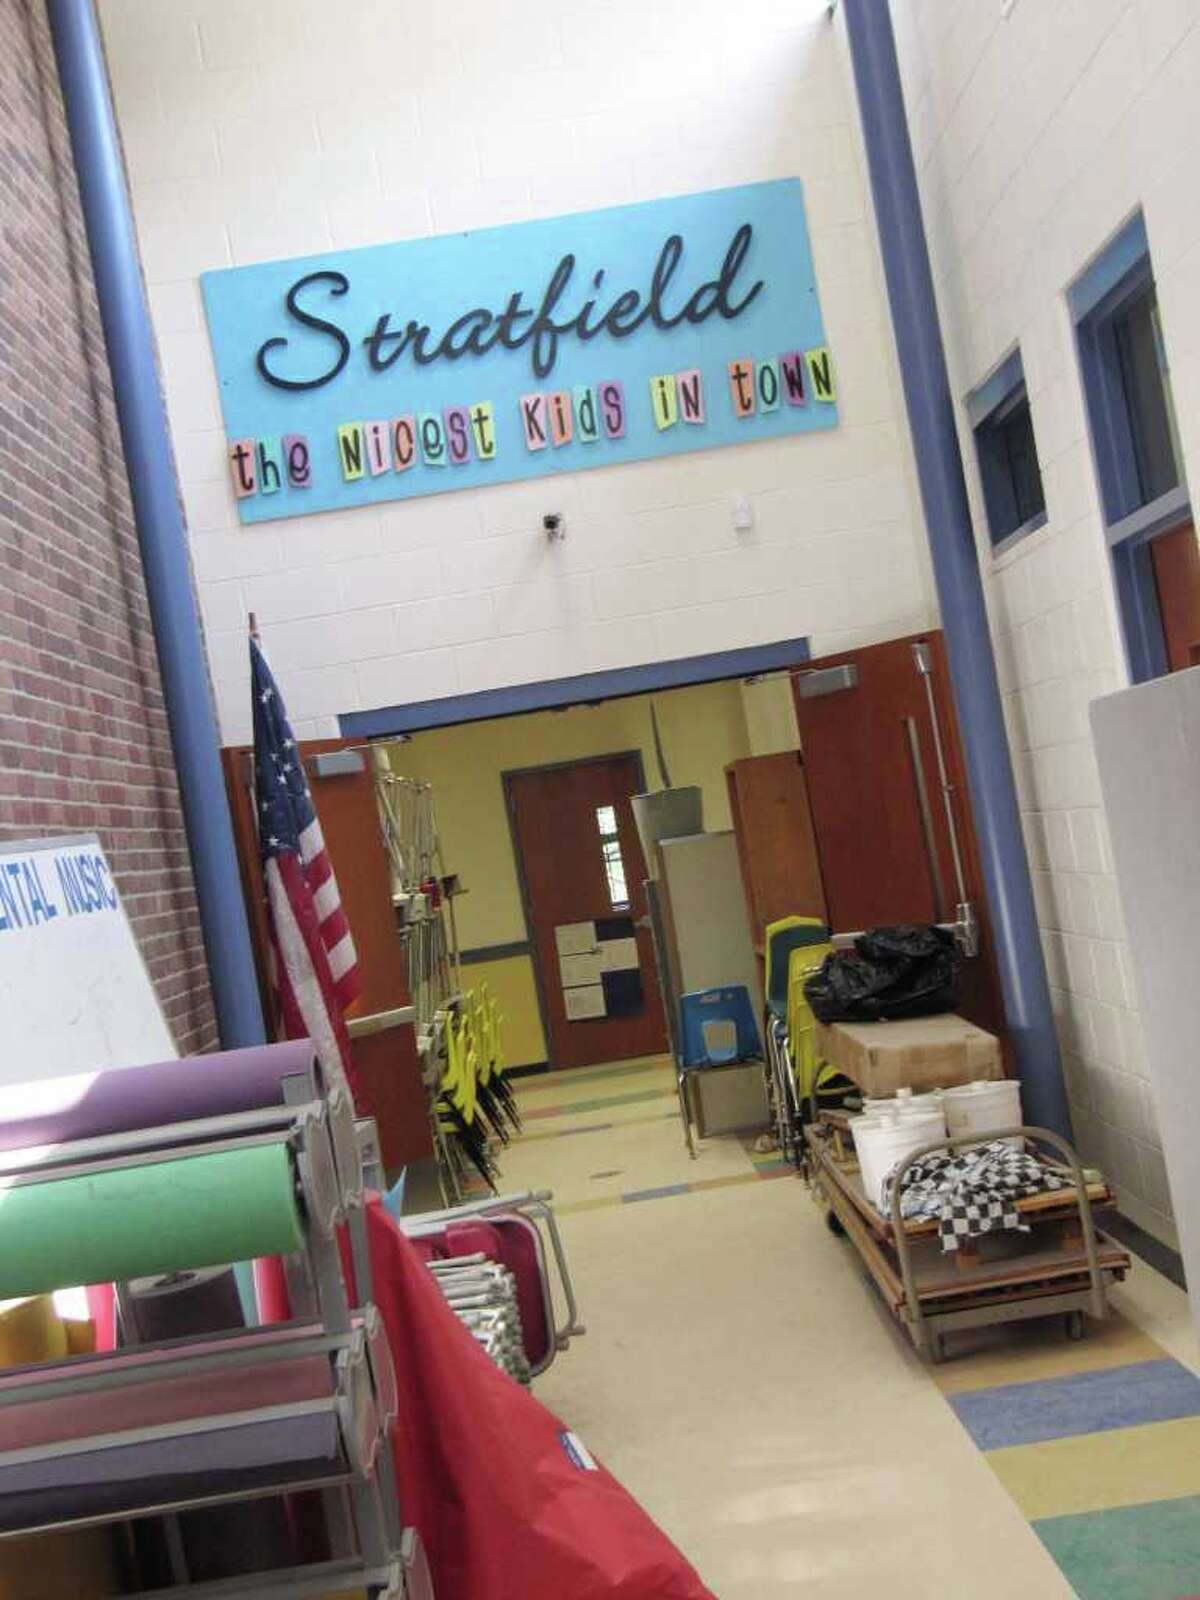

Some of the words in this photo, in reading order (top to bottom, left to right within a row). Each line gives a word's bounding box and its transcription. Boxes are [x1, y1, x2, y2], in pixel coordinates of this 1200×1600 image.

[255, 222, 766, 391] Stratfield
[231, 441, 310, 491] the
[0, 857, 57, 931] NTAL
[54, 853, 117, 916] MUSIC
